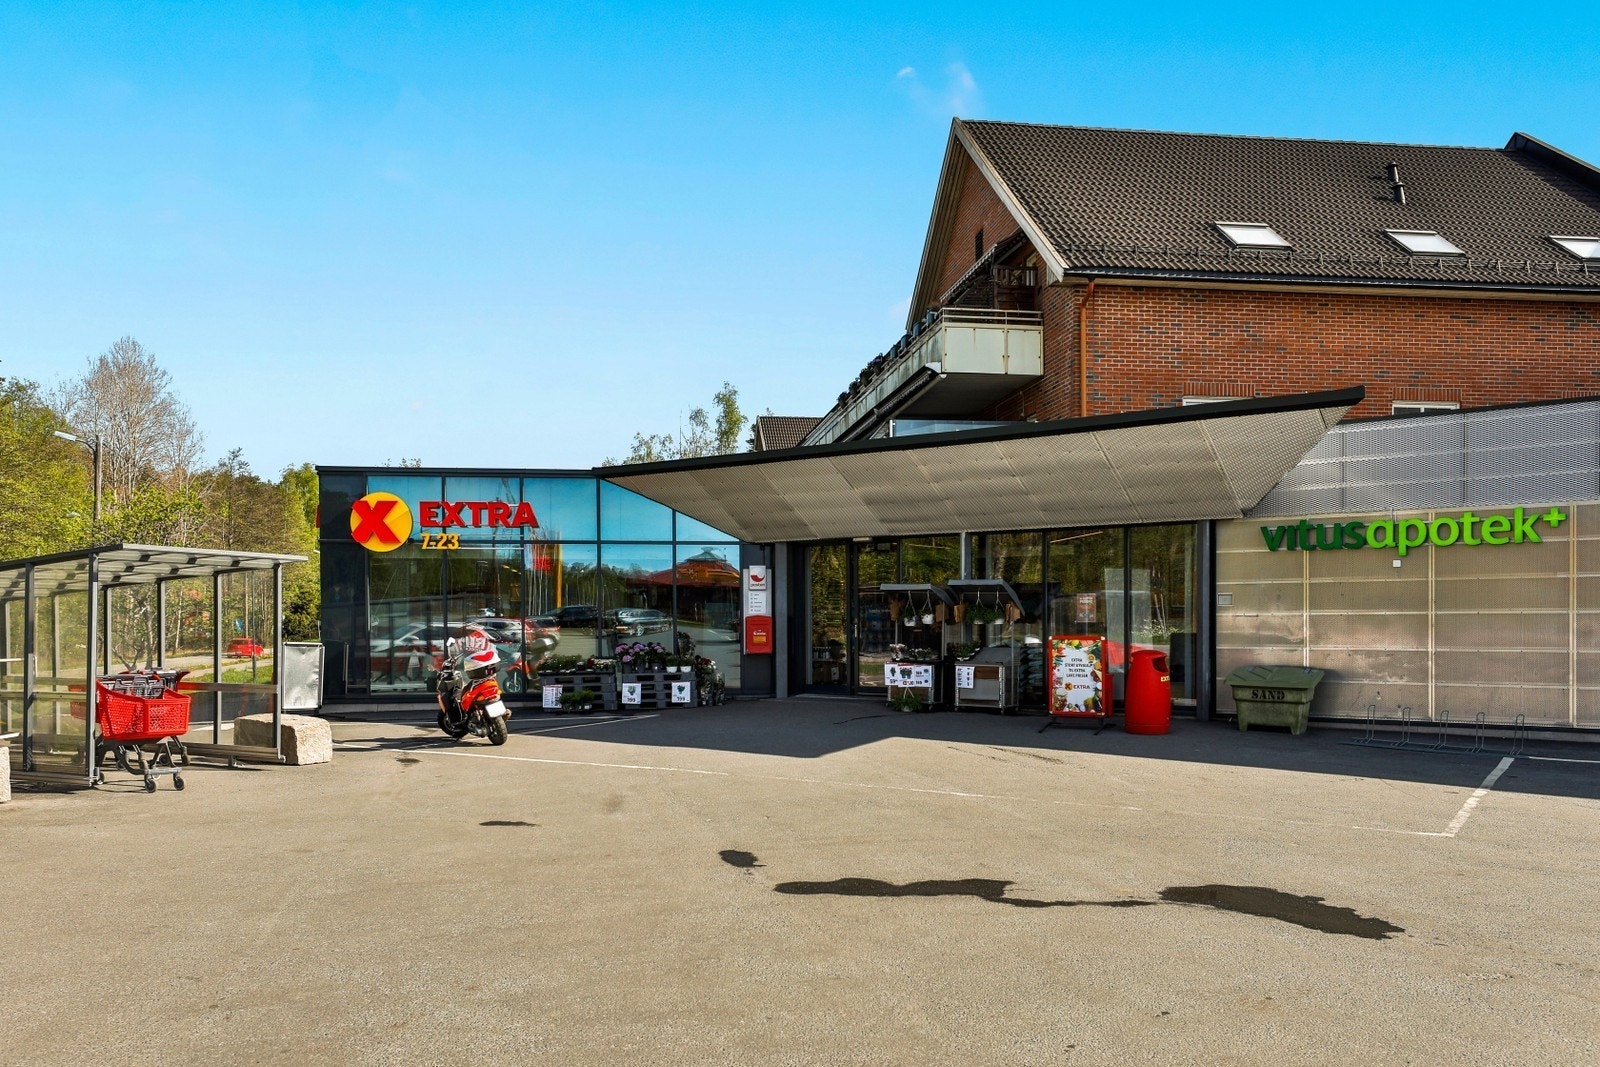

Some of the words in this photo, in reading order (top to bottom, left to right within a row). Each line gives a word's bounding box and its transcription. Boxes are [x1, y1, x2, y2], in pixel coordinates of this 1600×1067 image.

[351, 500, 400, 544] X
[419, 501, 539, 528] EXTRA
[421, 532, 460, 550] 7-23
[1251, 689, 1286, 701] SAND
